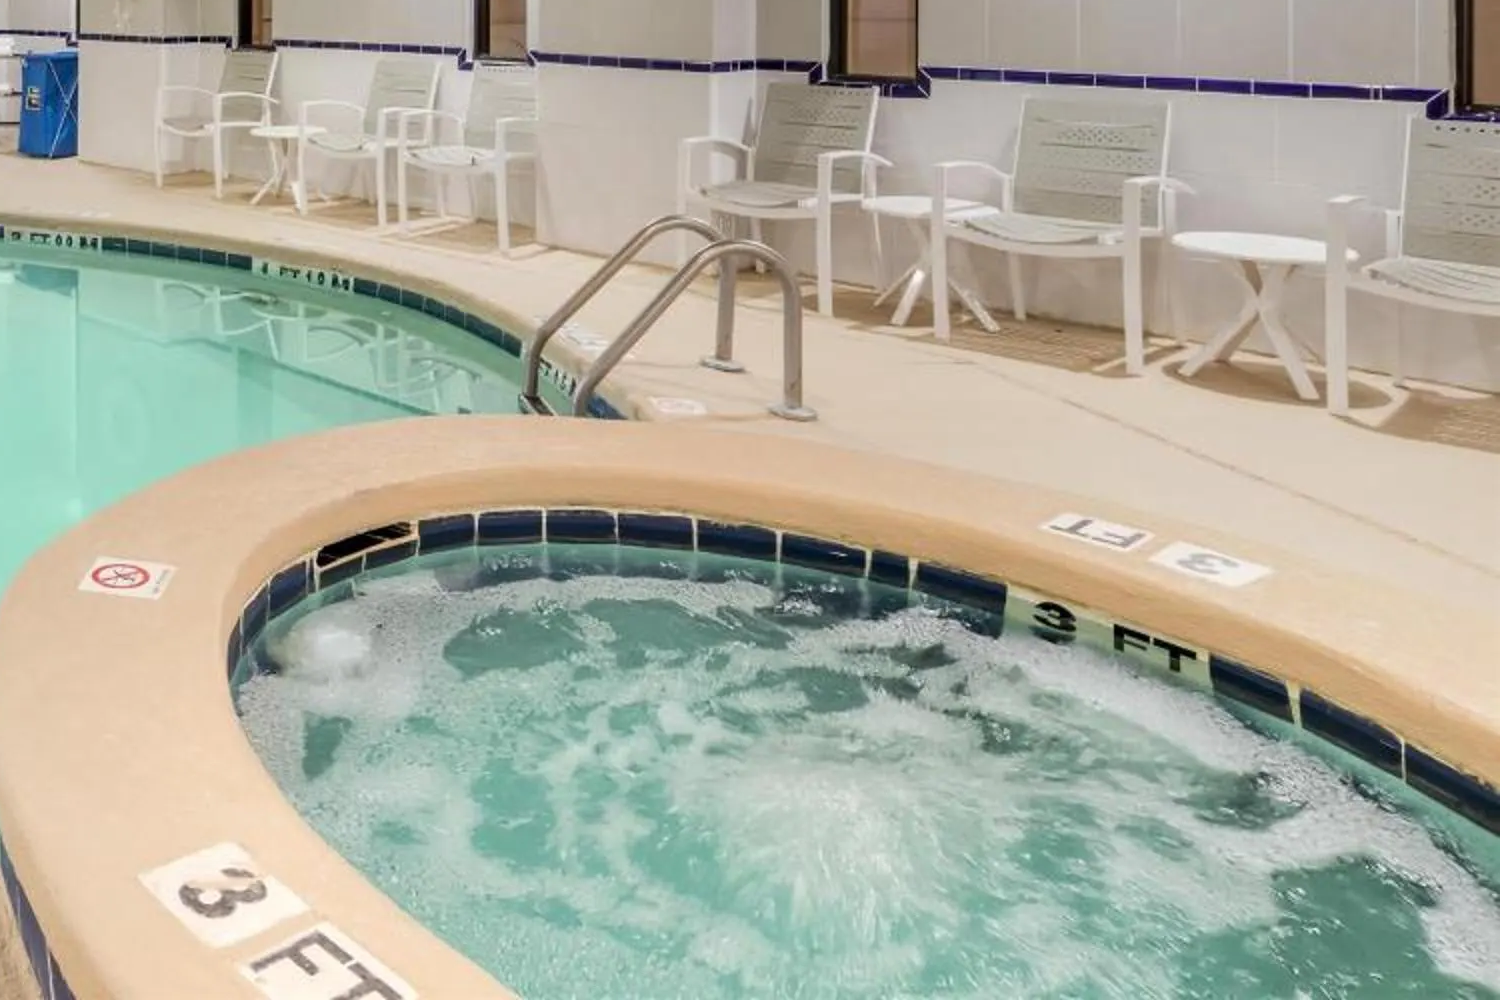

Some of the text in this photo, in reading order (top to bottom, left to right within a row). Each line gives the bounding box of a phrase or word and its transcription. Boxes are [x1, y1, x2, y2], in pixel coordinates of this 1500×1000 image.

[1050, 517, 1240, 576] 3 FT
[1032, 600, 1197, 673] 3 FT
[178, 867, 404, 1000] 3 FT
